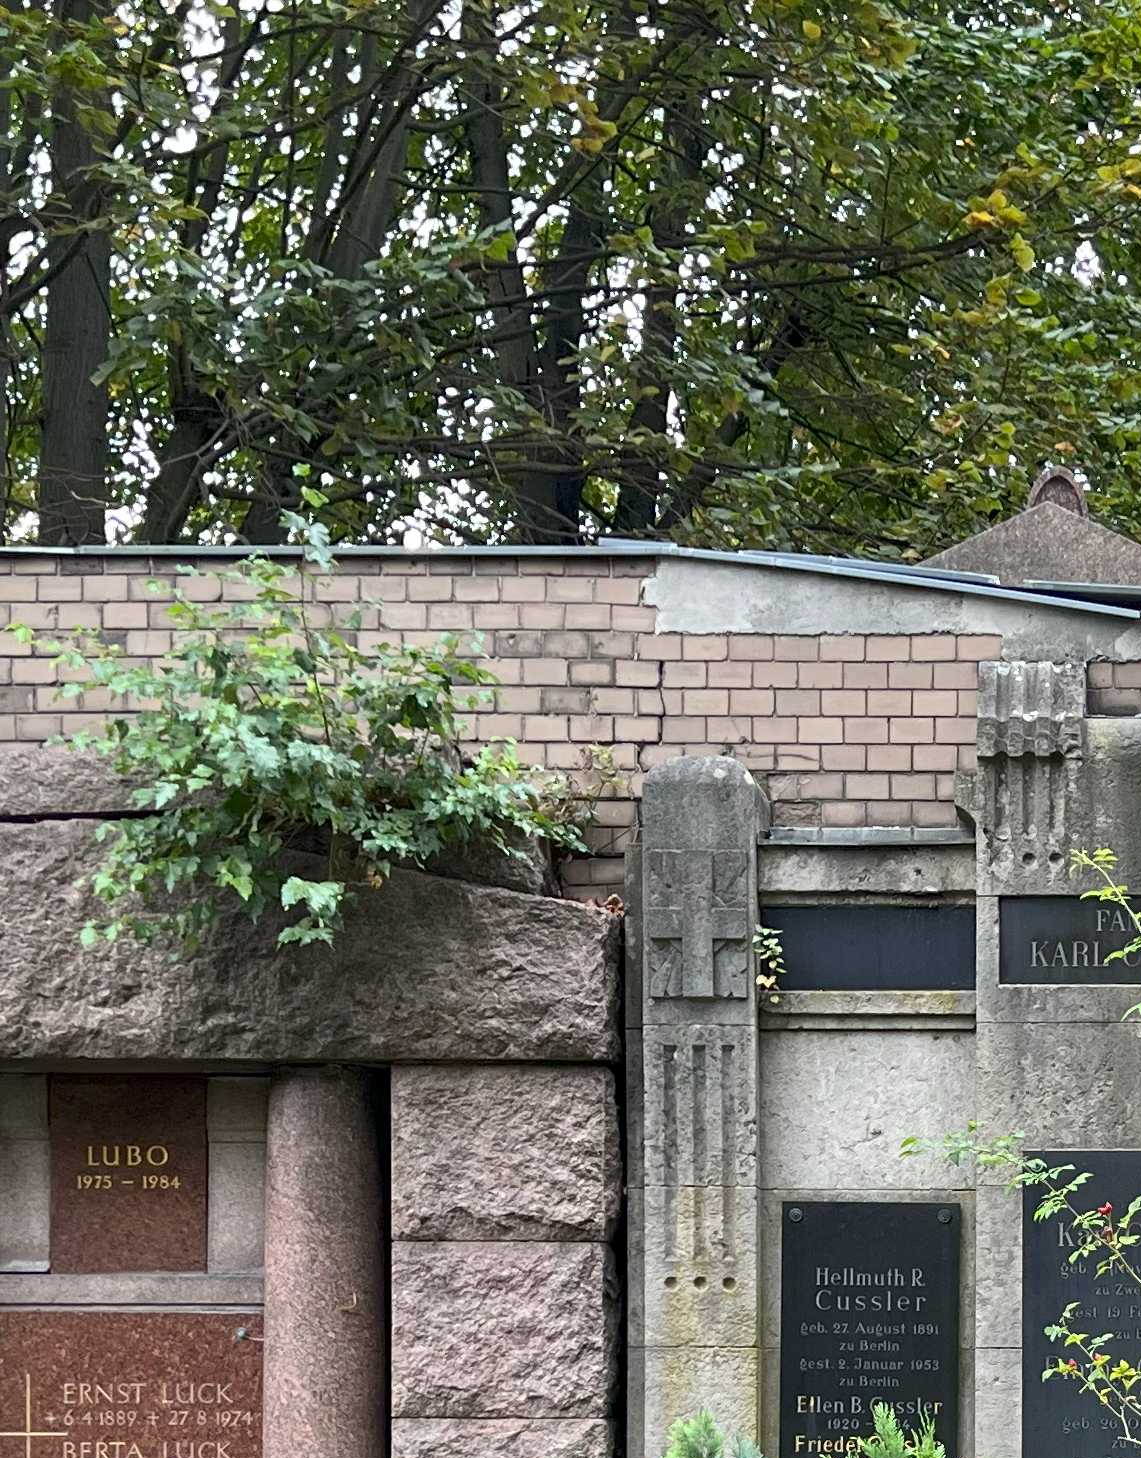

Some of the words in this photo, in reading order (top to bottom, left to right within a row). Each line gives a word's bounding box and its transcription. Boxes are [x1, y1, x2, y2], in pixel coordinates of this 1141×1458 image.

[1030, 941, 1109, 967] KARL
[87, 1145, 169, 1167] LUBO
[76, 1175, 113, 1190] 1975
[141, 1175, 182, 1190] 1984
[815, 1267, 905, 1287] Hellmuth
[815, 1289, 927, 1311] Cussler
[800, 1321, 828, 1336] geb.
[855, 1322, 906, 1337] August
[913, 1324, 939, 1336] 1891
[839, 1341, 854, 1352] zu
[859, 1339, 900, 1351] Berlin
[853, 1358, 904, 1371] Januar
[910, 1359, 940, 1371] 1953
[839, 1377, 854, 1387] zu
[859, 1375, 900, 1387] Berlin
[63, 1383, 147, 1404] ERNST
[797, 1396, 845, 1414] Ellen
[828, 1418, 860, 1431] 1920
